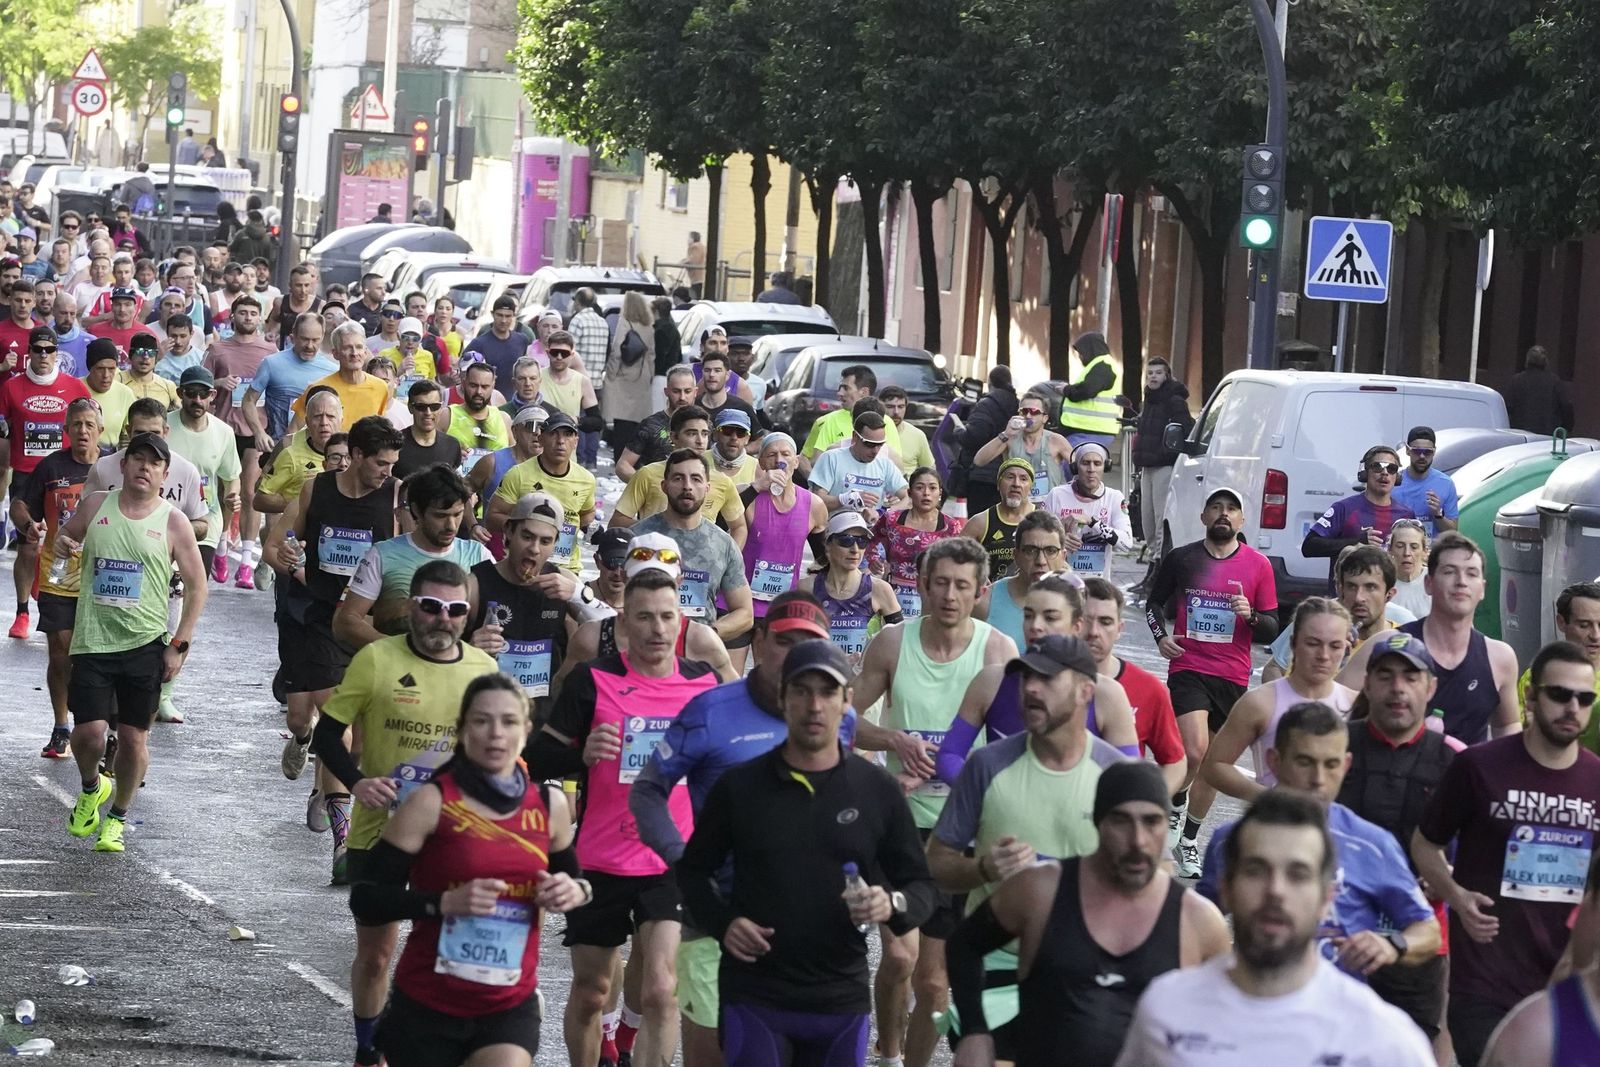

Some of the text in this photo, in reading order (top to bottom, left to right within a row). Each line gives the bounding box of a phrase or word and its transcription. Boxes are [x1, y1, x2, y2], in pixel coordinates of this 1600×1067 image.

[80, 93, 100, 105] 30
[336, 530, 366, 540] ZURICH
[336, 544, 352, 553] 5949
[326, 552, 360, 566] JIMMY
[108, 561, 138, 571] ZURICH
[1073, 561, 1093, 570] LUNA
[100, 583, 132, 596] GARRY
[762, 582, 783, 593] MIKE
[1185, 588, 1233, 600] PRORUNNE
[1203, 599, 1232, 609] ZURICH
[1203, 613, 1219, 621] 6009
[831, 620, 862, 628] ZURICH
[1194, 620, 1226, 633] TEO SC
[832, 634, 849, 642] 7276
[513, 643, 546, 653] ZURICH
[513, 661, 533, 670] 7767
[519, 672, 550, 685] GRIMA
[384, 718, 433, 736] AMIGOS
[1537, 831, 1584, 844] ZURICH
[1506, 869, 1535, 883] ALEX
[460, 943, 508, 964] SOFIA
